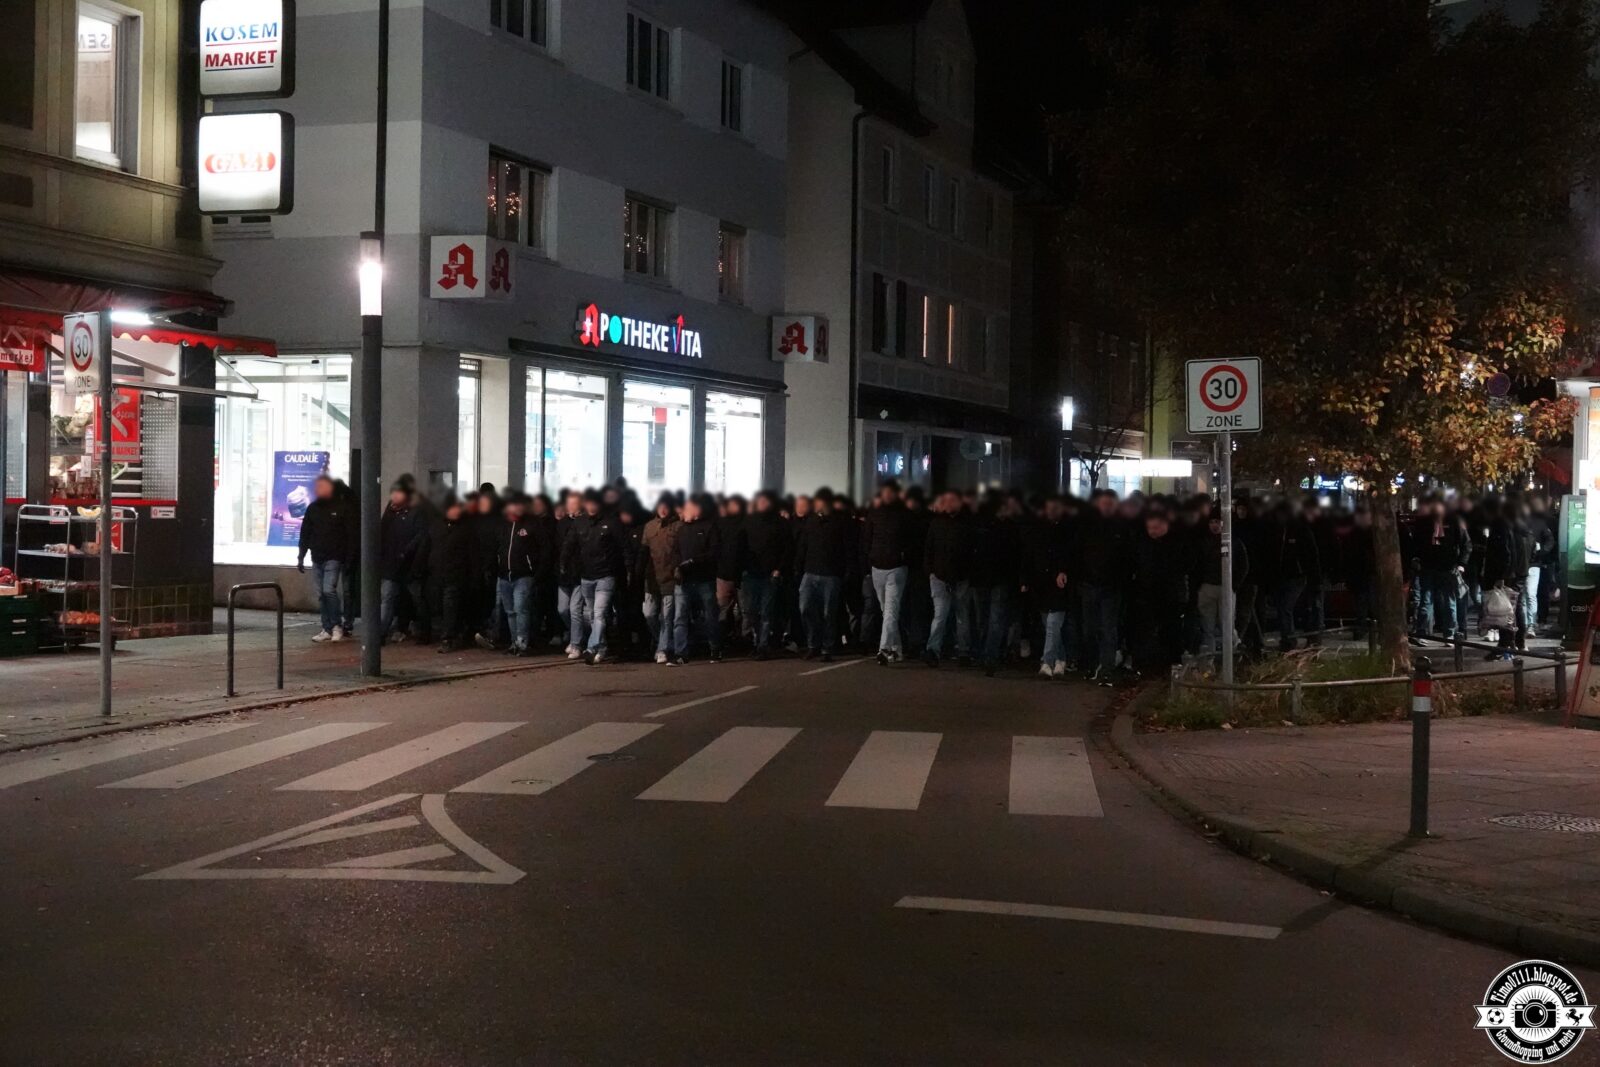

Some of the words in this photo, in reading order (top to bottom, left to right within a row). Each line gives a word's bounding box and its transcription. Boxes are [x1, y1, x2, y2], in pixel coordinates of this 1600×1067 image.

[205, 50, 277, 68] MARKET
[579, 303, 669, 353] APOTHEKE
[672, 314, 702, 358] VITA
[75, 334, 89, 358] 30
[1210, 378, 1237, 399] 30
[1206, 414, 1243, 427] ZONE
